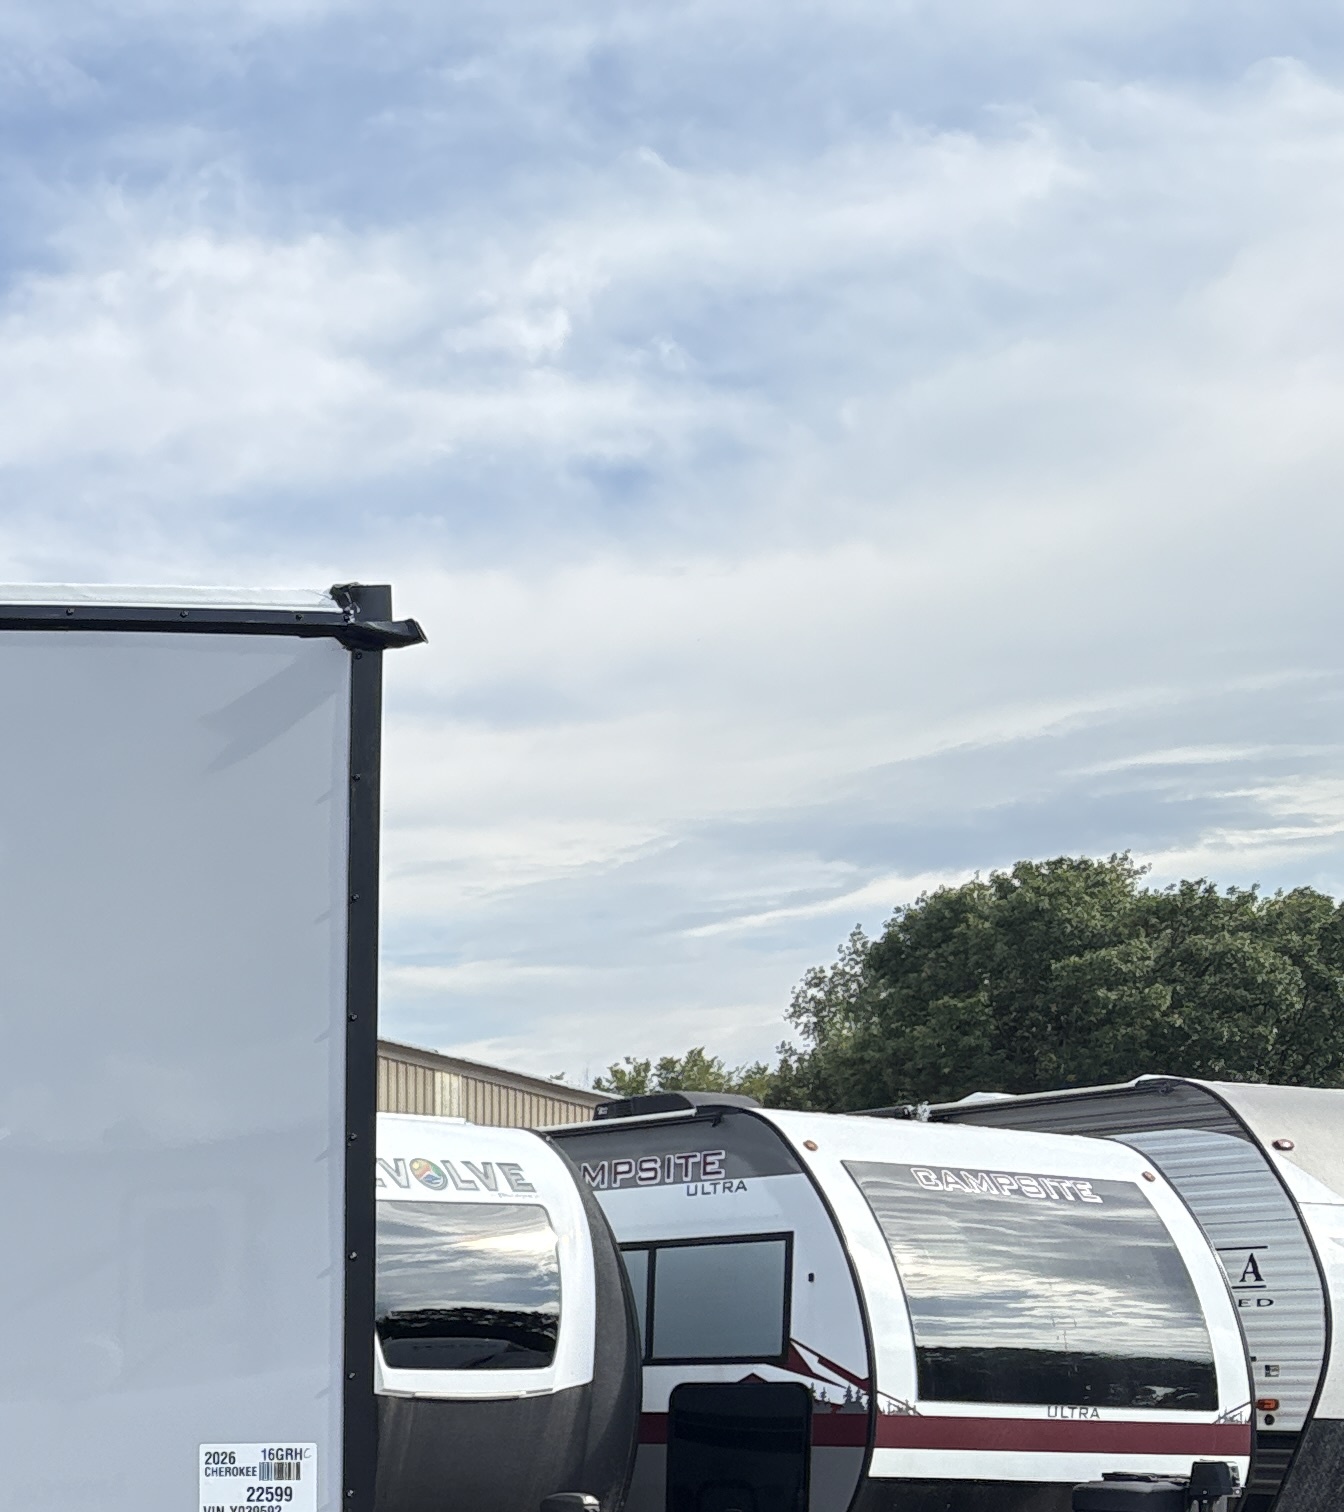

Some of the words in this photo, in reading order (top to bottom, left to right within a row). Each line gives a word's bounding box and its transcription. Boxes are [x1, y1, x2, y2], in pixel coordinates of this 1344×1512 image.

[376, 1157, 537, 1193] VOLVE
[686, 1180, 748, 1197] ULTRA
[912, 1168, 1103, 1203] CAMPSITE
[1239, 1252, 1265, 1283] A
[1238, 1298, 1274, 1307] ED
[1047, 1405, 1100, 1419] ULTRA
[204, 1451, 236, 1465] 2026
[261, 1447, 303, 1461] 16GRH
[204, 1466, 258, 1477] CHEROKEE
[246, 1486, 293, 1502] 22599
